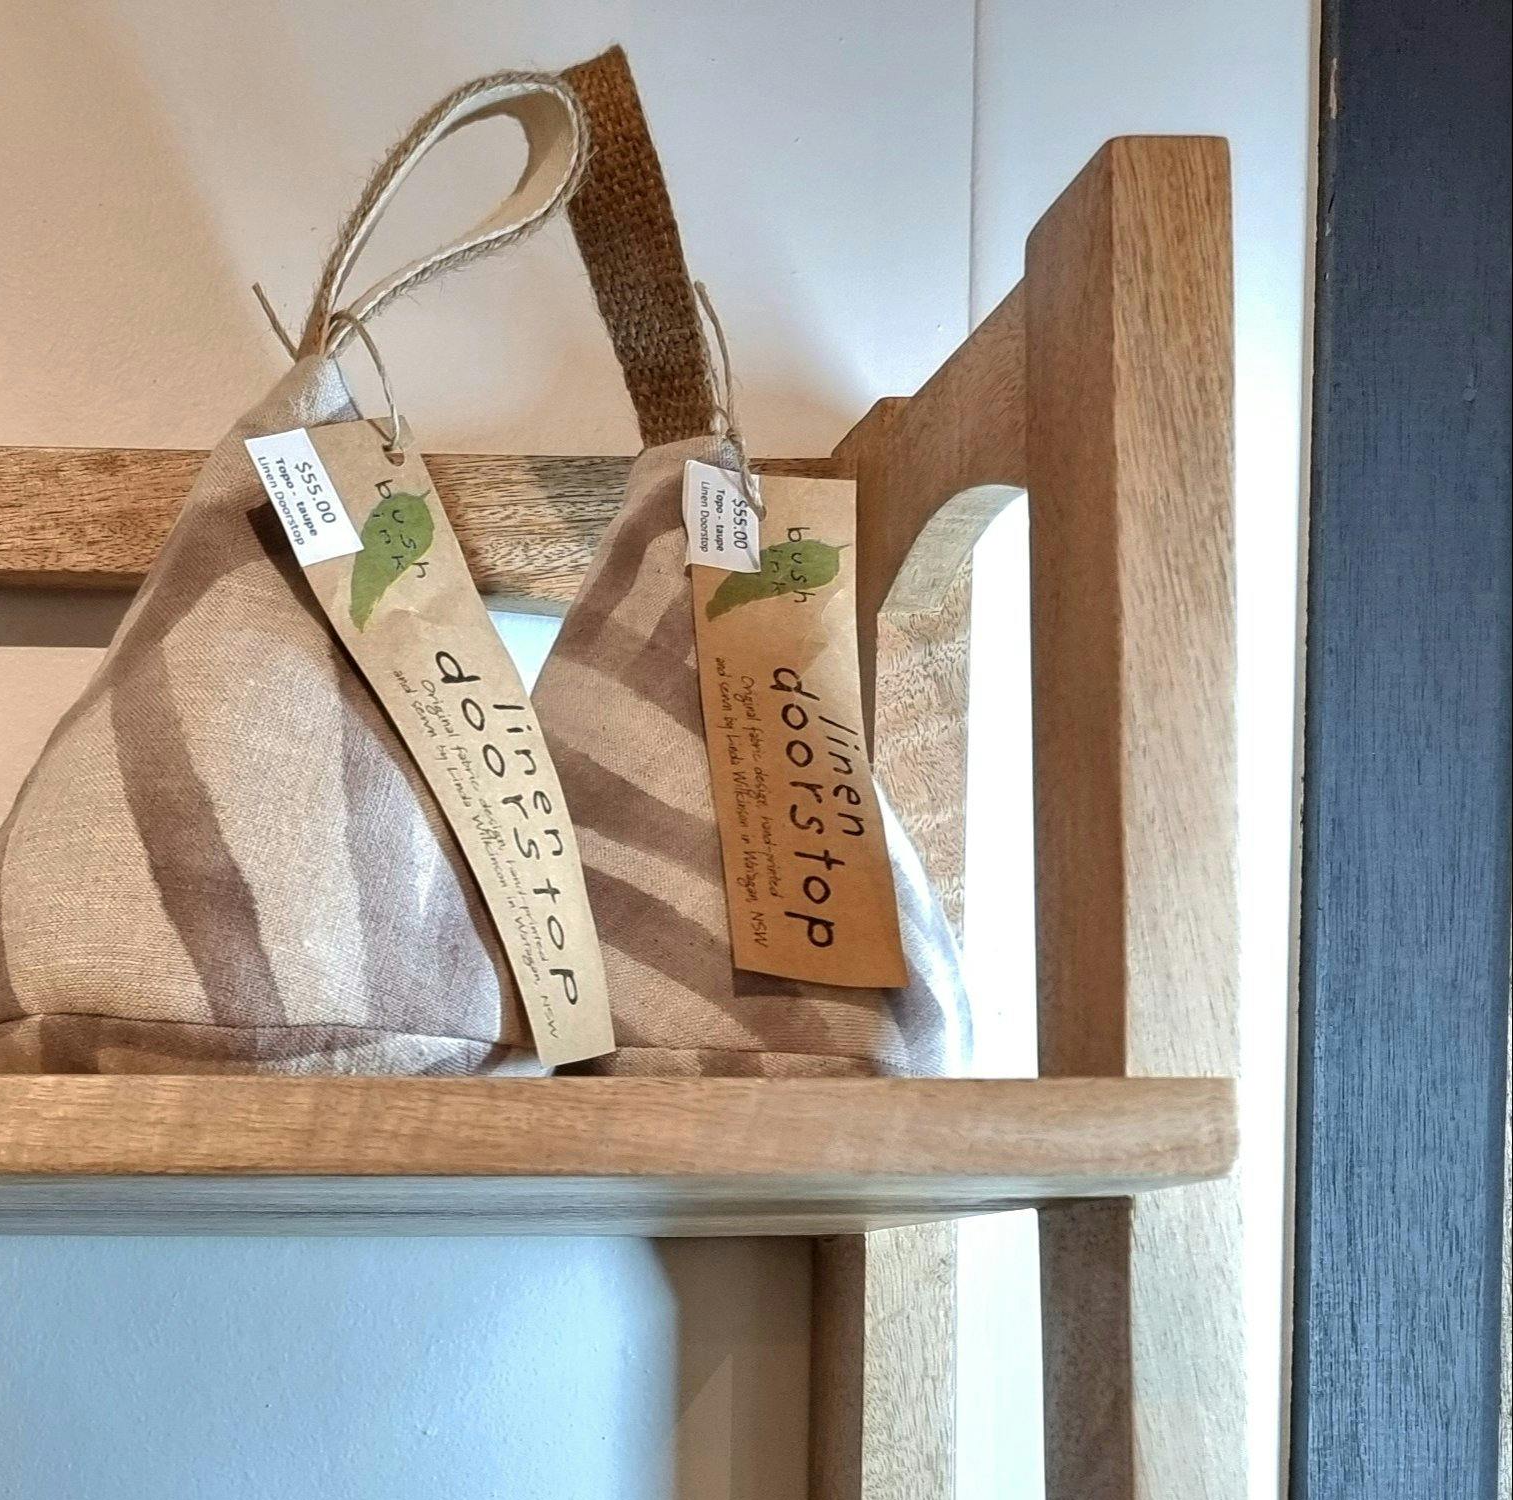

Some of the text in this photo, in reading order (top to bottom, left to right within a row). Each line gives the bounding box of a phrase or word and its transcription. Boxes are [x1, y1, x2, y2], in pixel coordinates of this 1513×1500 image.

[258, 456, 305, 546] Linen Doorstop
[275, 457, 295, 491] Topo
[296, 502, 318, 537] taupe
[294, 461, 336, 524] $55.00
[375, 479, 429, 578] bush
[699, 481, 711, 553] Linen Doorstop
[715, 488, 726, 514] Topo
[732, 498, 748, 549] $55.00
[373, 512, 405, 571] ink
[714, 524, 725, 552] taupe
[769, 546, 786, 592] ink
[787, 526, 816, 603] bush
[421, 679, 460, 738] Original
[451, 745, 479, 792] fabric
[733, 676, 761, 722] Original
[493, 704, 563, 856] linen
[743, 726, 764, 762] fabric
[819, 715, 865, 836] linen
[436, 651, 578, 1005] doorstop
[770, 668, 845, 947] doorstop
